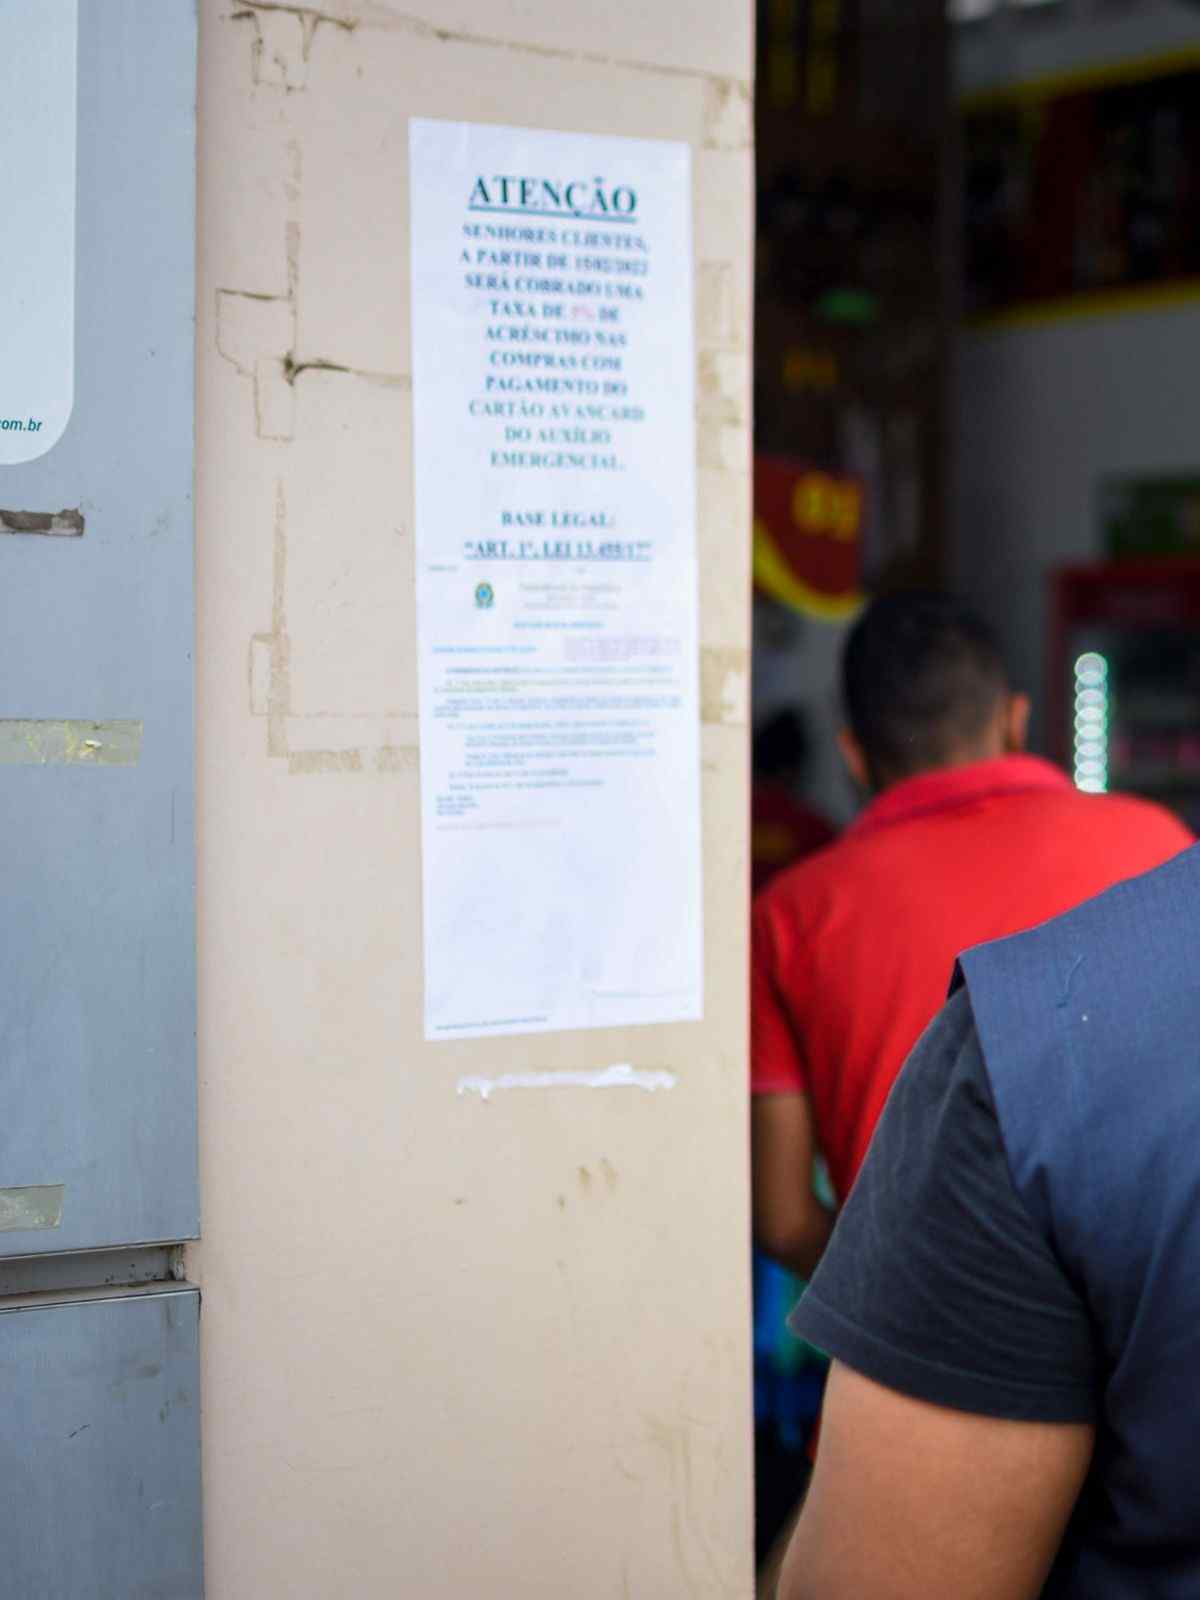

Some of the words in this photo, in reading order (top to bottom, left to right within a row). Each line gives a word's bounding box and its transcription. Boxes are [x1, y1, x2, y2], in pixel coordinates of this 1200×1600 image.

[469, 175, 637, 216] ATENÇÃO
[462, 223, 557, 245] SENHORES
[460, 248, 470, 263] A
[476, 248, 542, 267] PARTIR
[546, 253, 568, 270] DE
[490, 300, 537, 318] TAXA
[542, 302, 564, 319] DE
[599, 304, 620, 322] DE
[489, 350, 577, 369] COMPRAS
[485, 375, 599, 394] PAGAMENTO
[602, 378, 628, 396] DO
[469, 398, 544, 416] CARTÃO
[0, 417, 42, 432] om.br
[505, 426, 531, 442] DO
[501, 510, 545, 527] BASE
